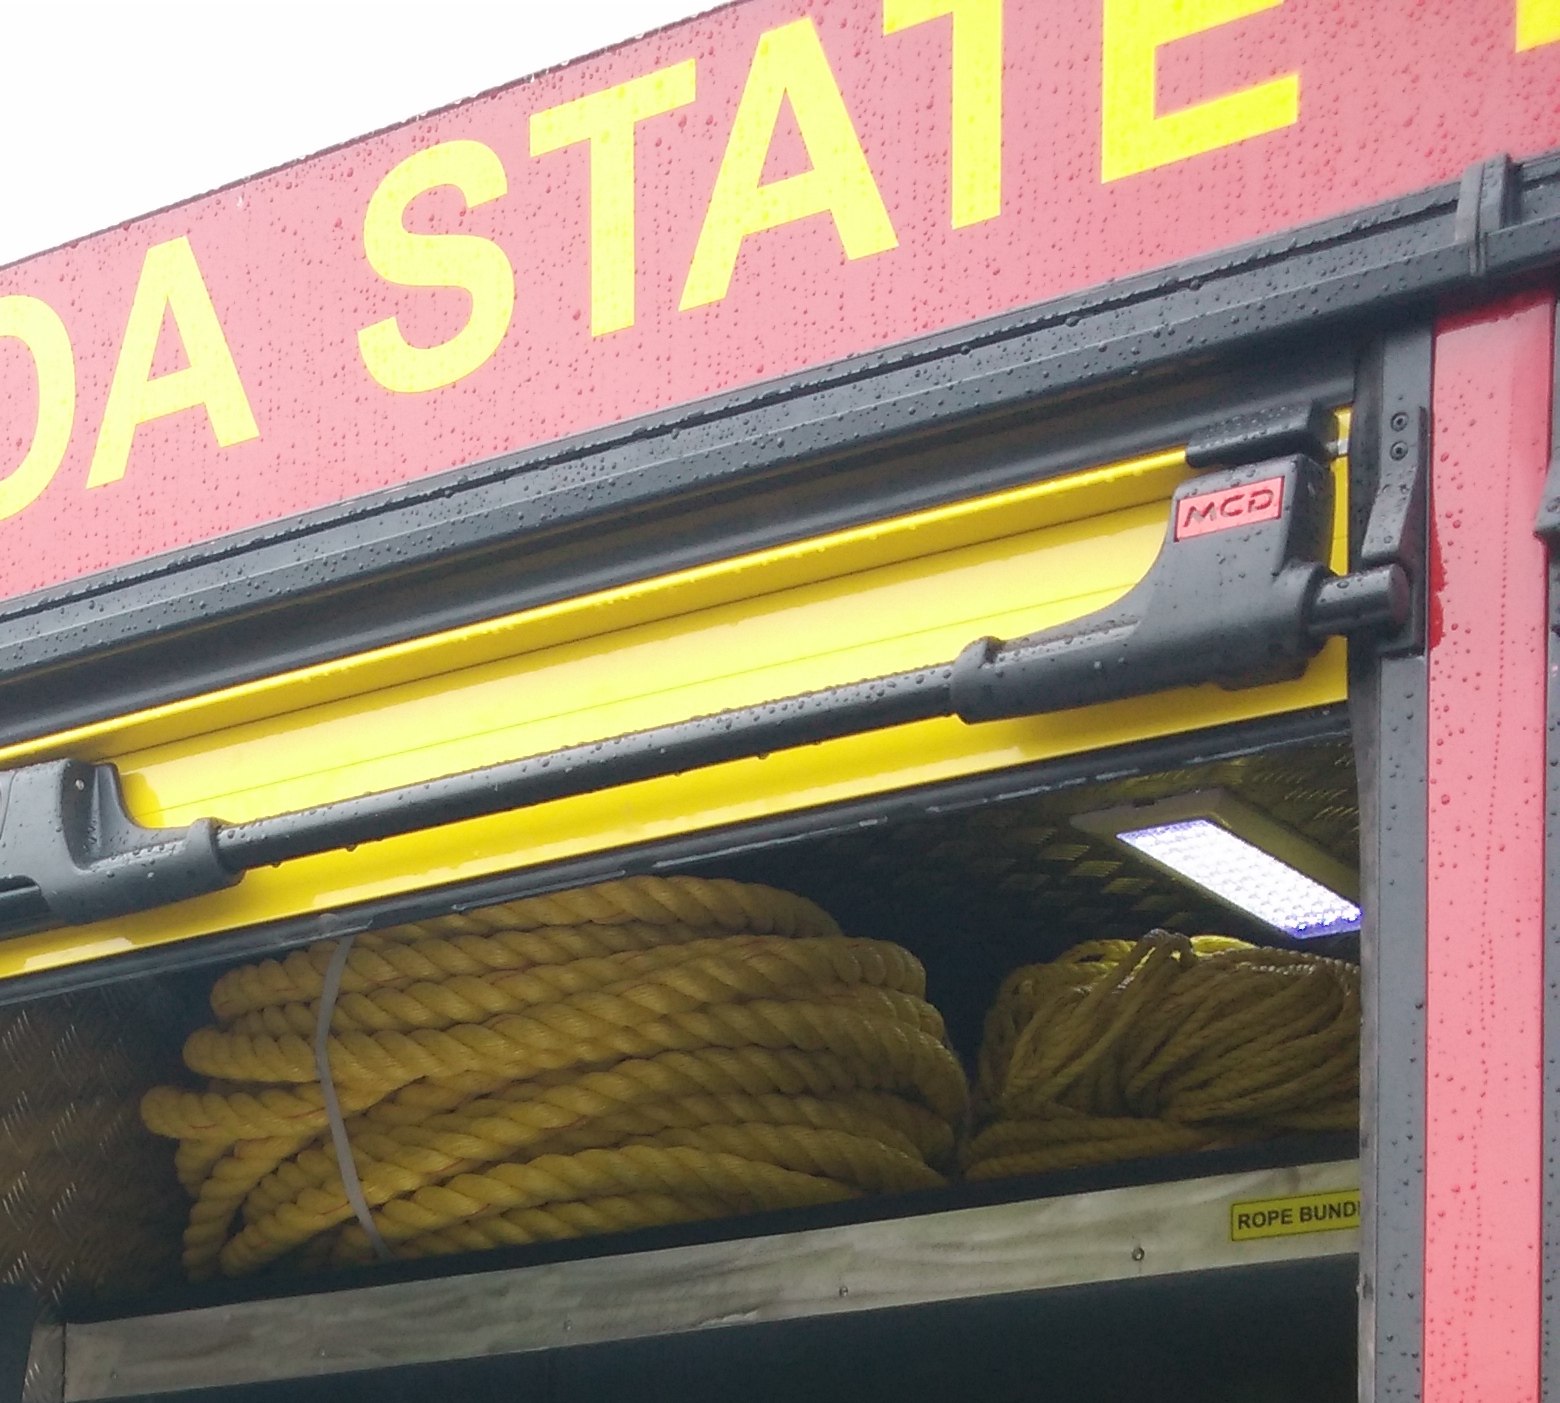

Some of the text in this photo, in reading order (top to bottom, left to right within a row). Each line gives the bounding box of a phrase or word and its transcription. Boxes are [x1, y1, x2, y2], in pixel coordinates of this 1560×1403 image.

[356, 0, 1299, 395] STATE
[1183, 488, 1274, 528] MCD
[1237, 1207, 1294, 1230] ROPE
